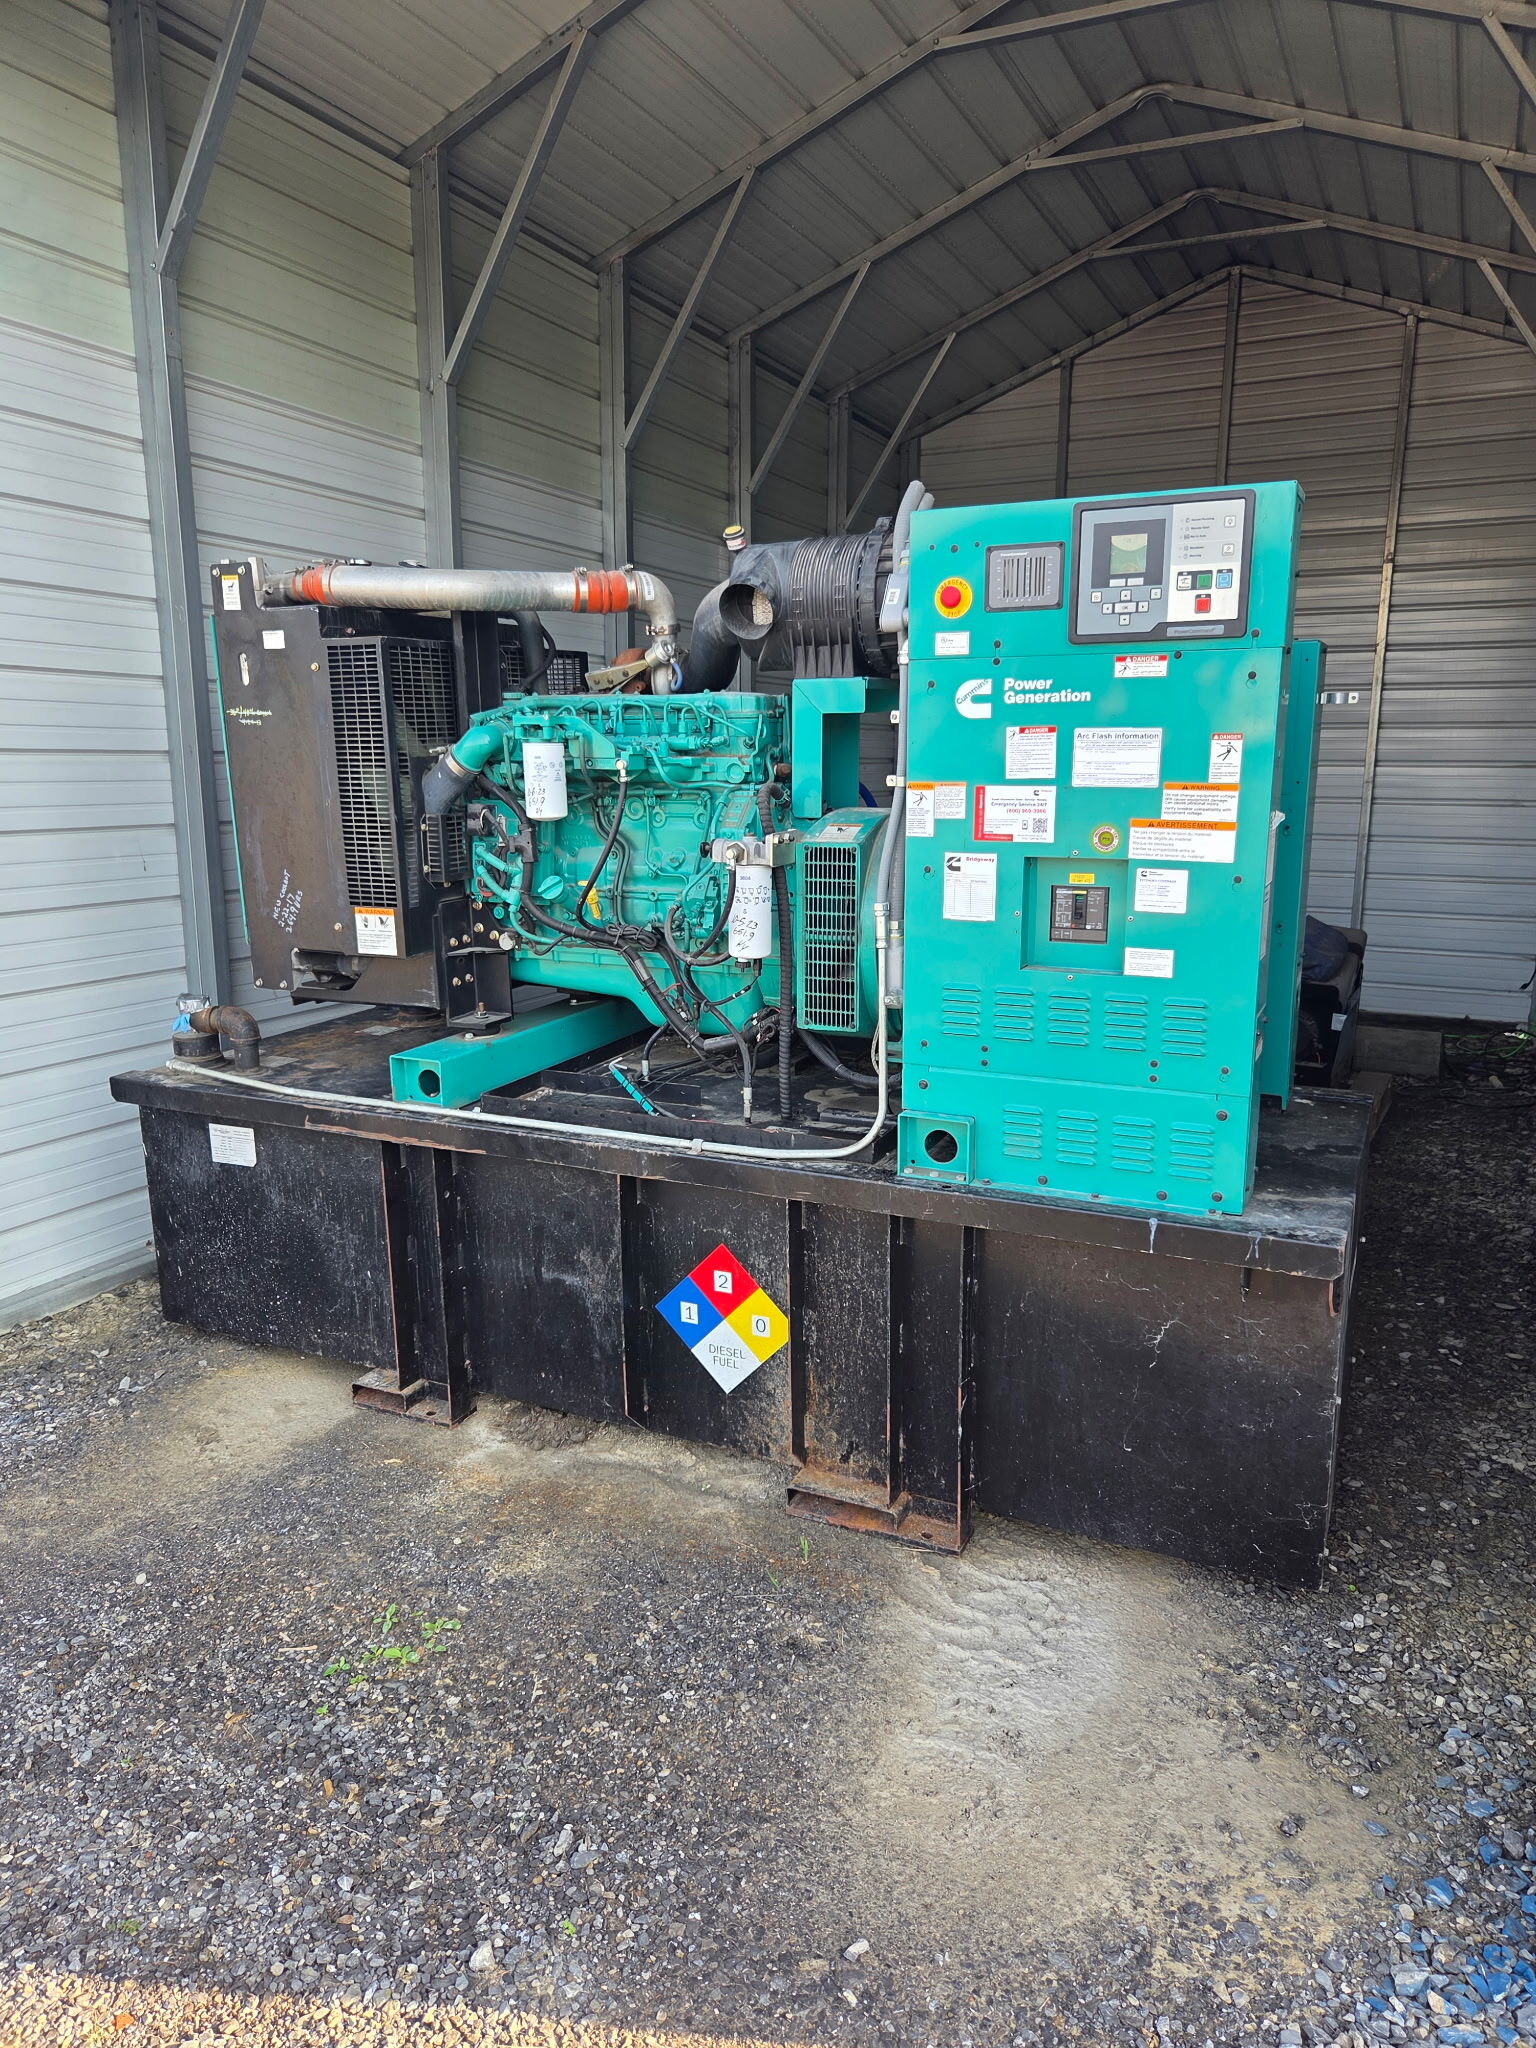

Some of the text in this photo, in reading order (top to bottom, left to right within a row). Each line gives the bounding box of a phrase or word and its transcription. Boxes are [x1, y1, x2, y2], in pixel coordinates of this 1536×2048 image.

[1004, 678, 1053, 691] Power
[956, 679, 989, 705] Cummins
[1004, 690, 1092, 704] Generation
[1077, 732, 1159, 740] Arc Flash Information
[1156, 821, 1218, 829] AVERTISSEMENT
[273, 899, 282, 920] NEW
[718, 1274, 728, 1289] 2
[685, 1306, 766, 1333] 1 0
[709, 1344, 746, 1360] DIESEL
[713, 1356, 739, 1369] FUEL
